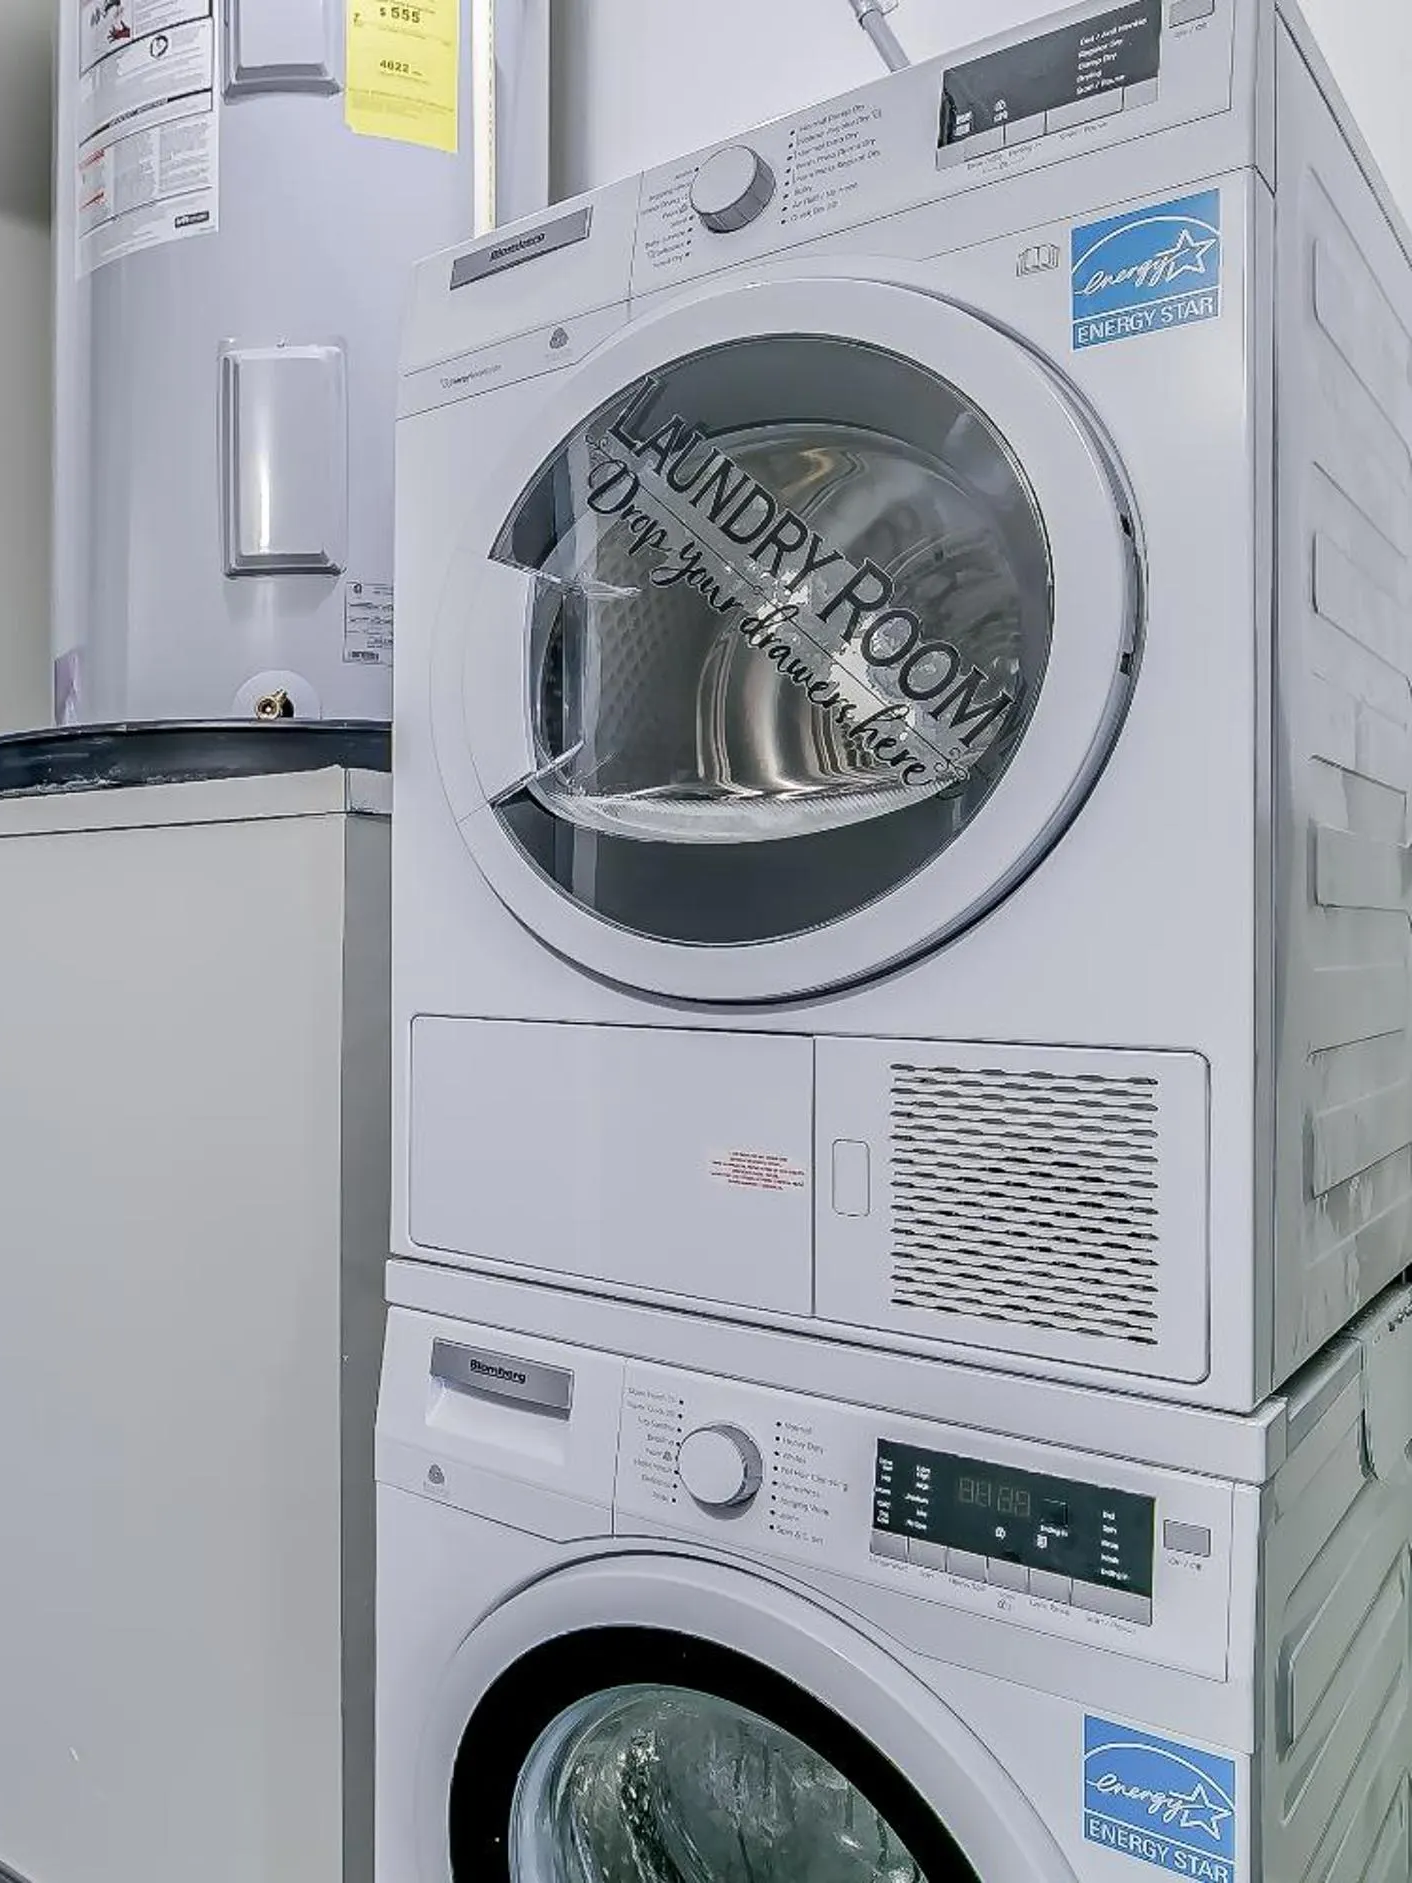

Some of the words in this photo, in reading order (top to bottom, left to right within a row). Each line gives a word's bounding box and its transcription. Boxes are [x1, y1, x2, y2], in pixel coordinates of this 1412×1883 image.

[1077, 311, 1155, 344] ENERGY
[1160, 296, 1215, 327] STAR
[586, 458, 674, 556] Drop
[650, 540, 743, 617] your
[740, 603, 858, 724] drawers
[845, 704, 931, 786] here
[608, 375, 844, 594] LAUNDRY
[818, 557, 1015, 750] ROOM
[1089, 1818, 1170, 1863] ENERGY
[1174, 1850, 1229, 1883] STAR
